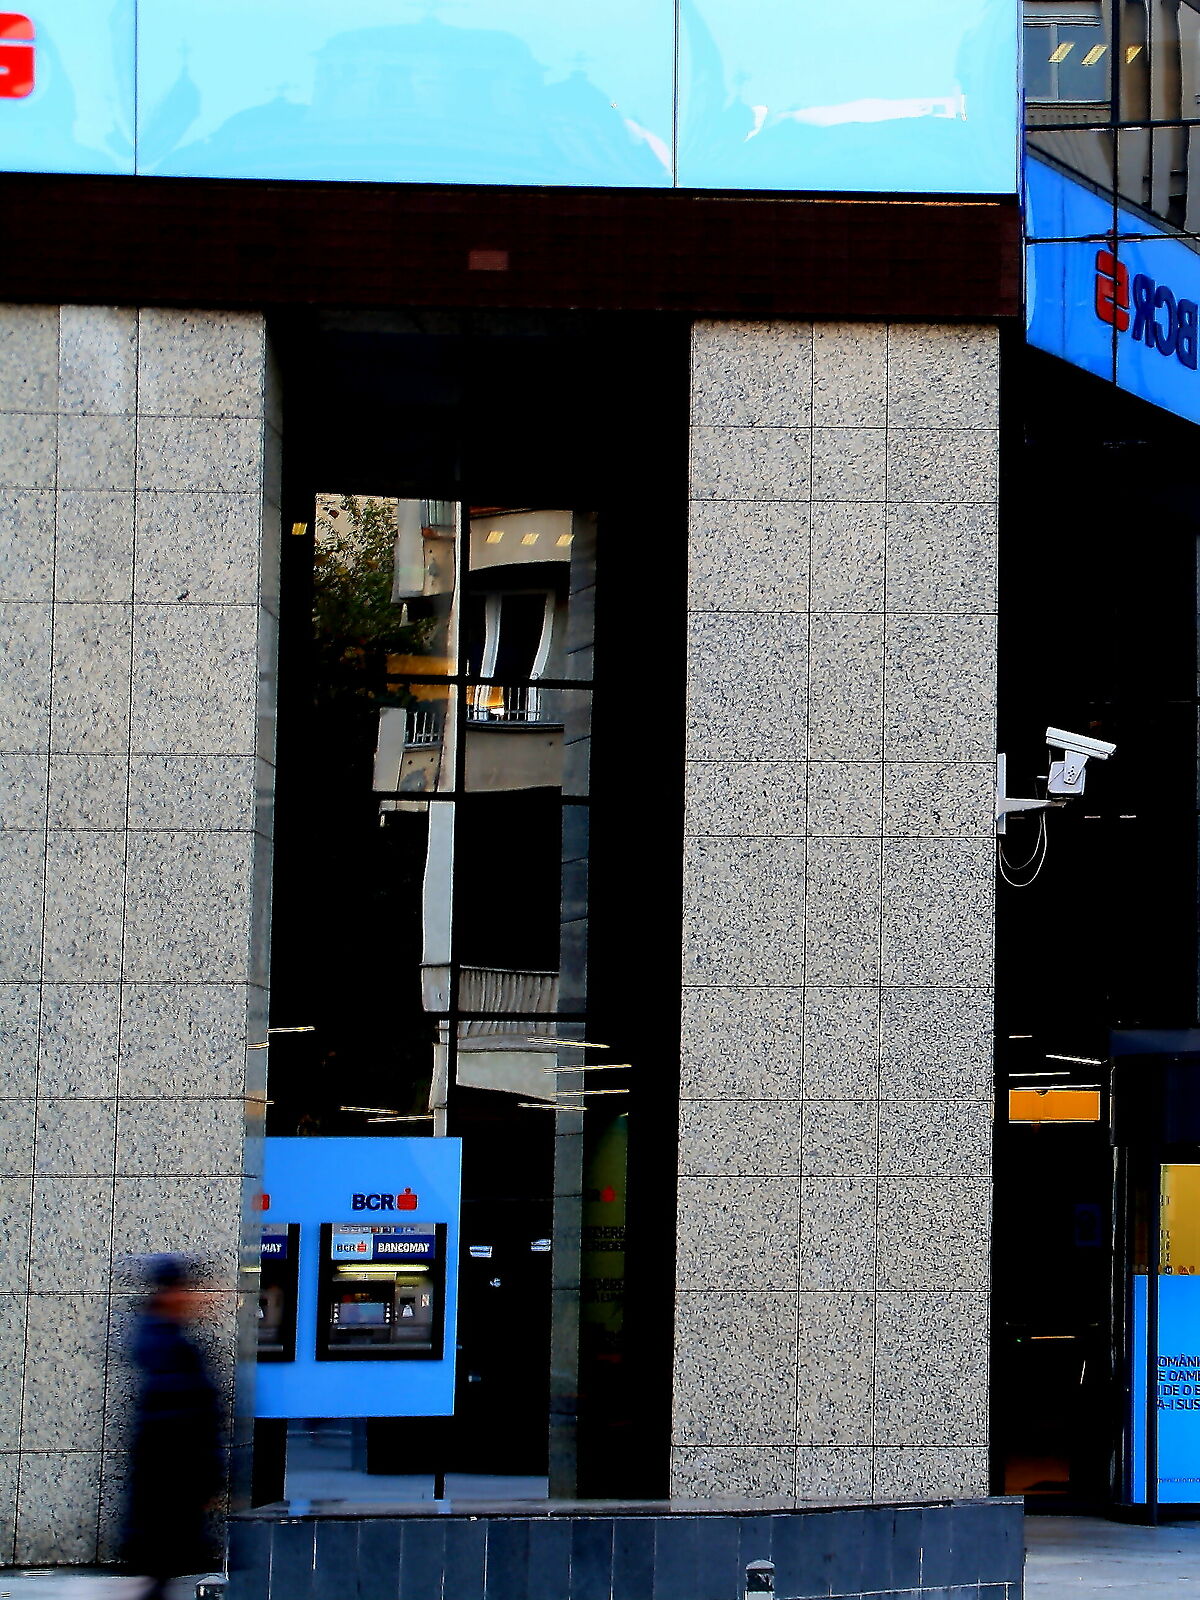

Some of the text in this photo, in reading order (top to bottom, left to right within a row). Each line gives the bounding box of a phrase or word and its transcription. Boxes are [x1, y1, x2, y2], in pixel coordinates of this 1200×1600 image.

[352, 1194, 395, 1210] BCR
[336, 1243, 357, 1252] BCR
[377, 1242, 430, 1253] BANCOMAT
[1163, 1385, 1179, 1395] DE
